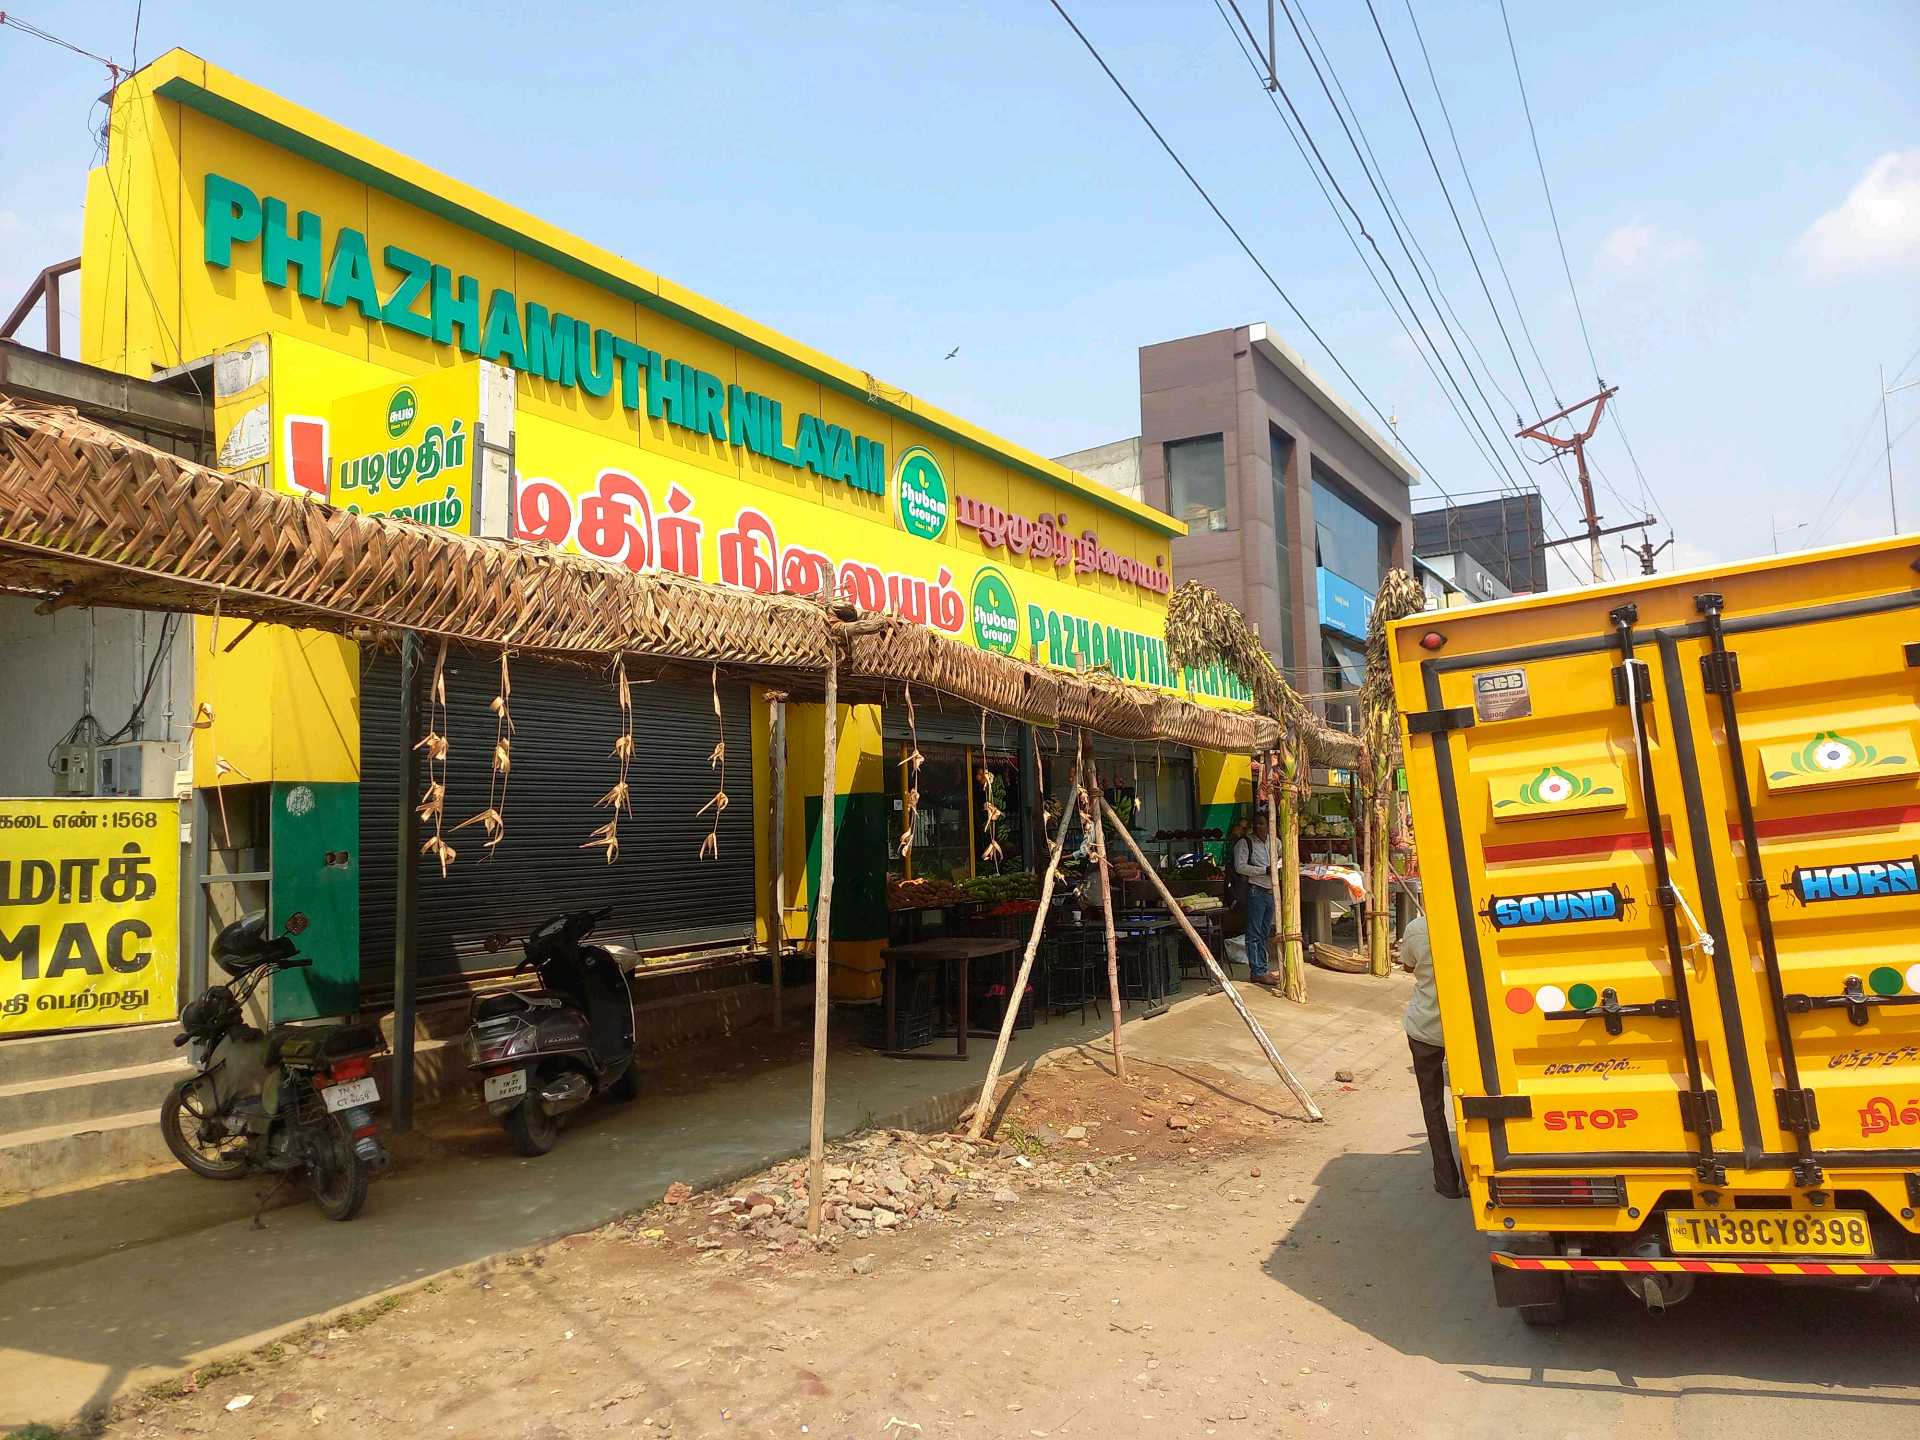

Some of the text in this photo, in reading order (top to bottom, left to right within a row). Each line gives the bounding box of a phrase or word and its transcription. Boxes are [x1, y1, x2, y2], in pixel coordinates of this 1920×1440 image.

[340, 420, 465, 494] பழமுதிர்
[901, 481, 946, 516] Shubam
[908, 502, 940, 528] Groups
[974, 605, 1017, 632] Shubam
[982, 625, 1012, 645] Groups
[53, 810, 97, 829] எண்
[1799, 861, 1918, 900] HORN
[1495, 889, 1617, 925] SOUND
[36, 985, 149, 1012] பெற்றது
[1544, 1108, 1639, 1131] STOP
[1687, 1216, 1866, 1247] TN38CY8398
